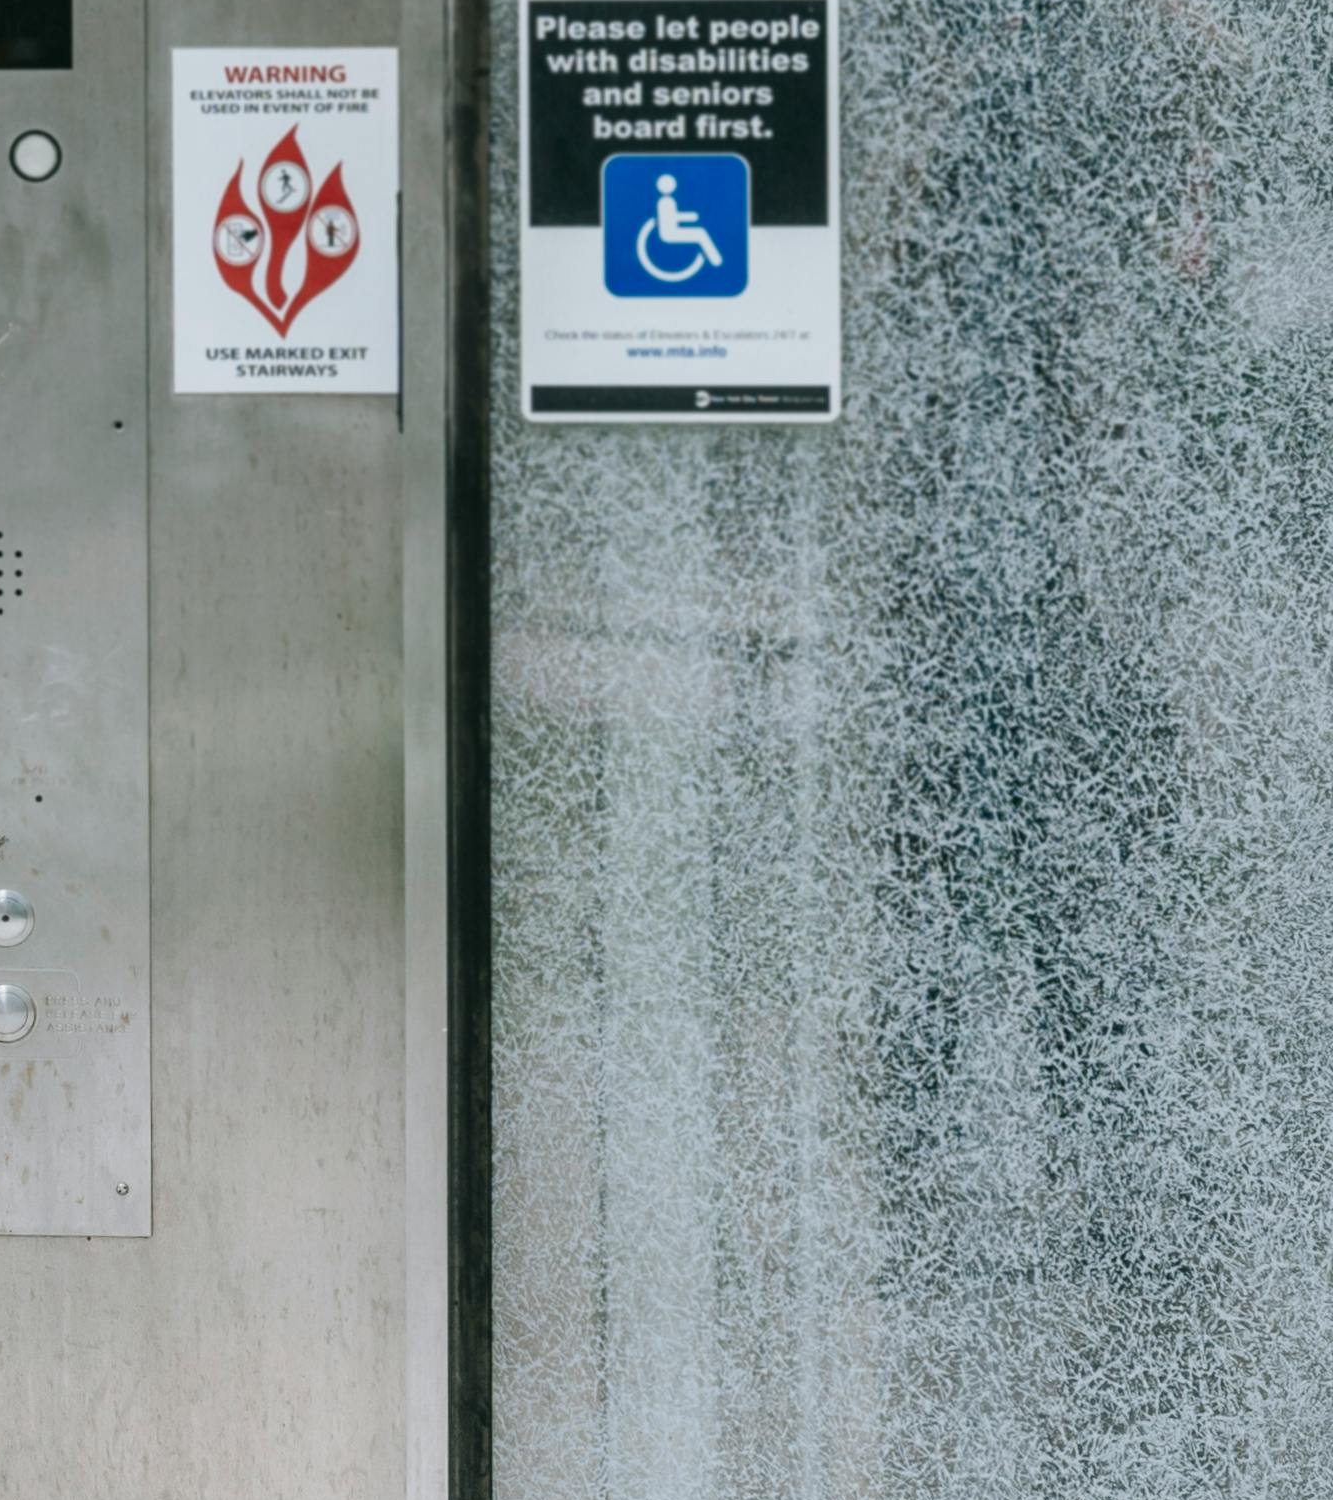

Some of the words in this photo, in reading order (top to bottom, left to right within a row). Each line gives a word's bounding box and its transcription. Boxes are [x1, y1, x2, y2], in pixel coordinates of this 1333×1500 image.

[537, 16, 645, 40] Please
[657, 16, 699, 39] let
[710, 15, 819, 45] people
[547, 49, 618, 73] with
[629, 48, 809, 72] disabilities
[225, 65, 346, 84] WARNING
[191, 90, 272, 100] ELEVATORS
[277, 89, 321, 99] SHALL
[327, 89, 357, 99] NOT
[361, 89, 378, 99] BE
[583, 82, 642, 106] and
[653, 82, 773, 106] seniors
[201, 104, 240, 113] USED
[244, 104, 259, 113] IN
[263, 103, 309, 113] EVENT
[314, 103, 333, 113] OF
[337, 103, 367, 113] FIRE
[594, 115, 685, 139] board
[695, 114, 773, 138] first.
[207, 348, 237, 360] USE
[245, 348, 324, 360] MARKED
[329, 347, 367, 360] EXIT
[237, 365, 337, 377] STAIRWAYS
